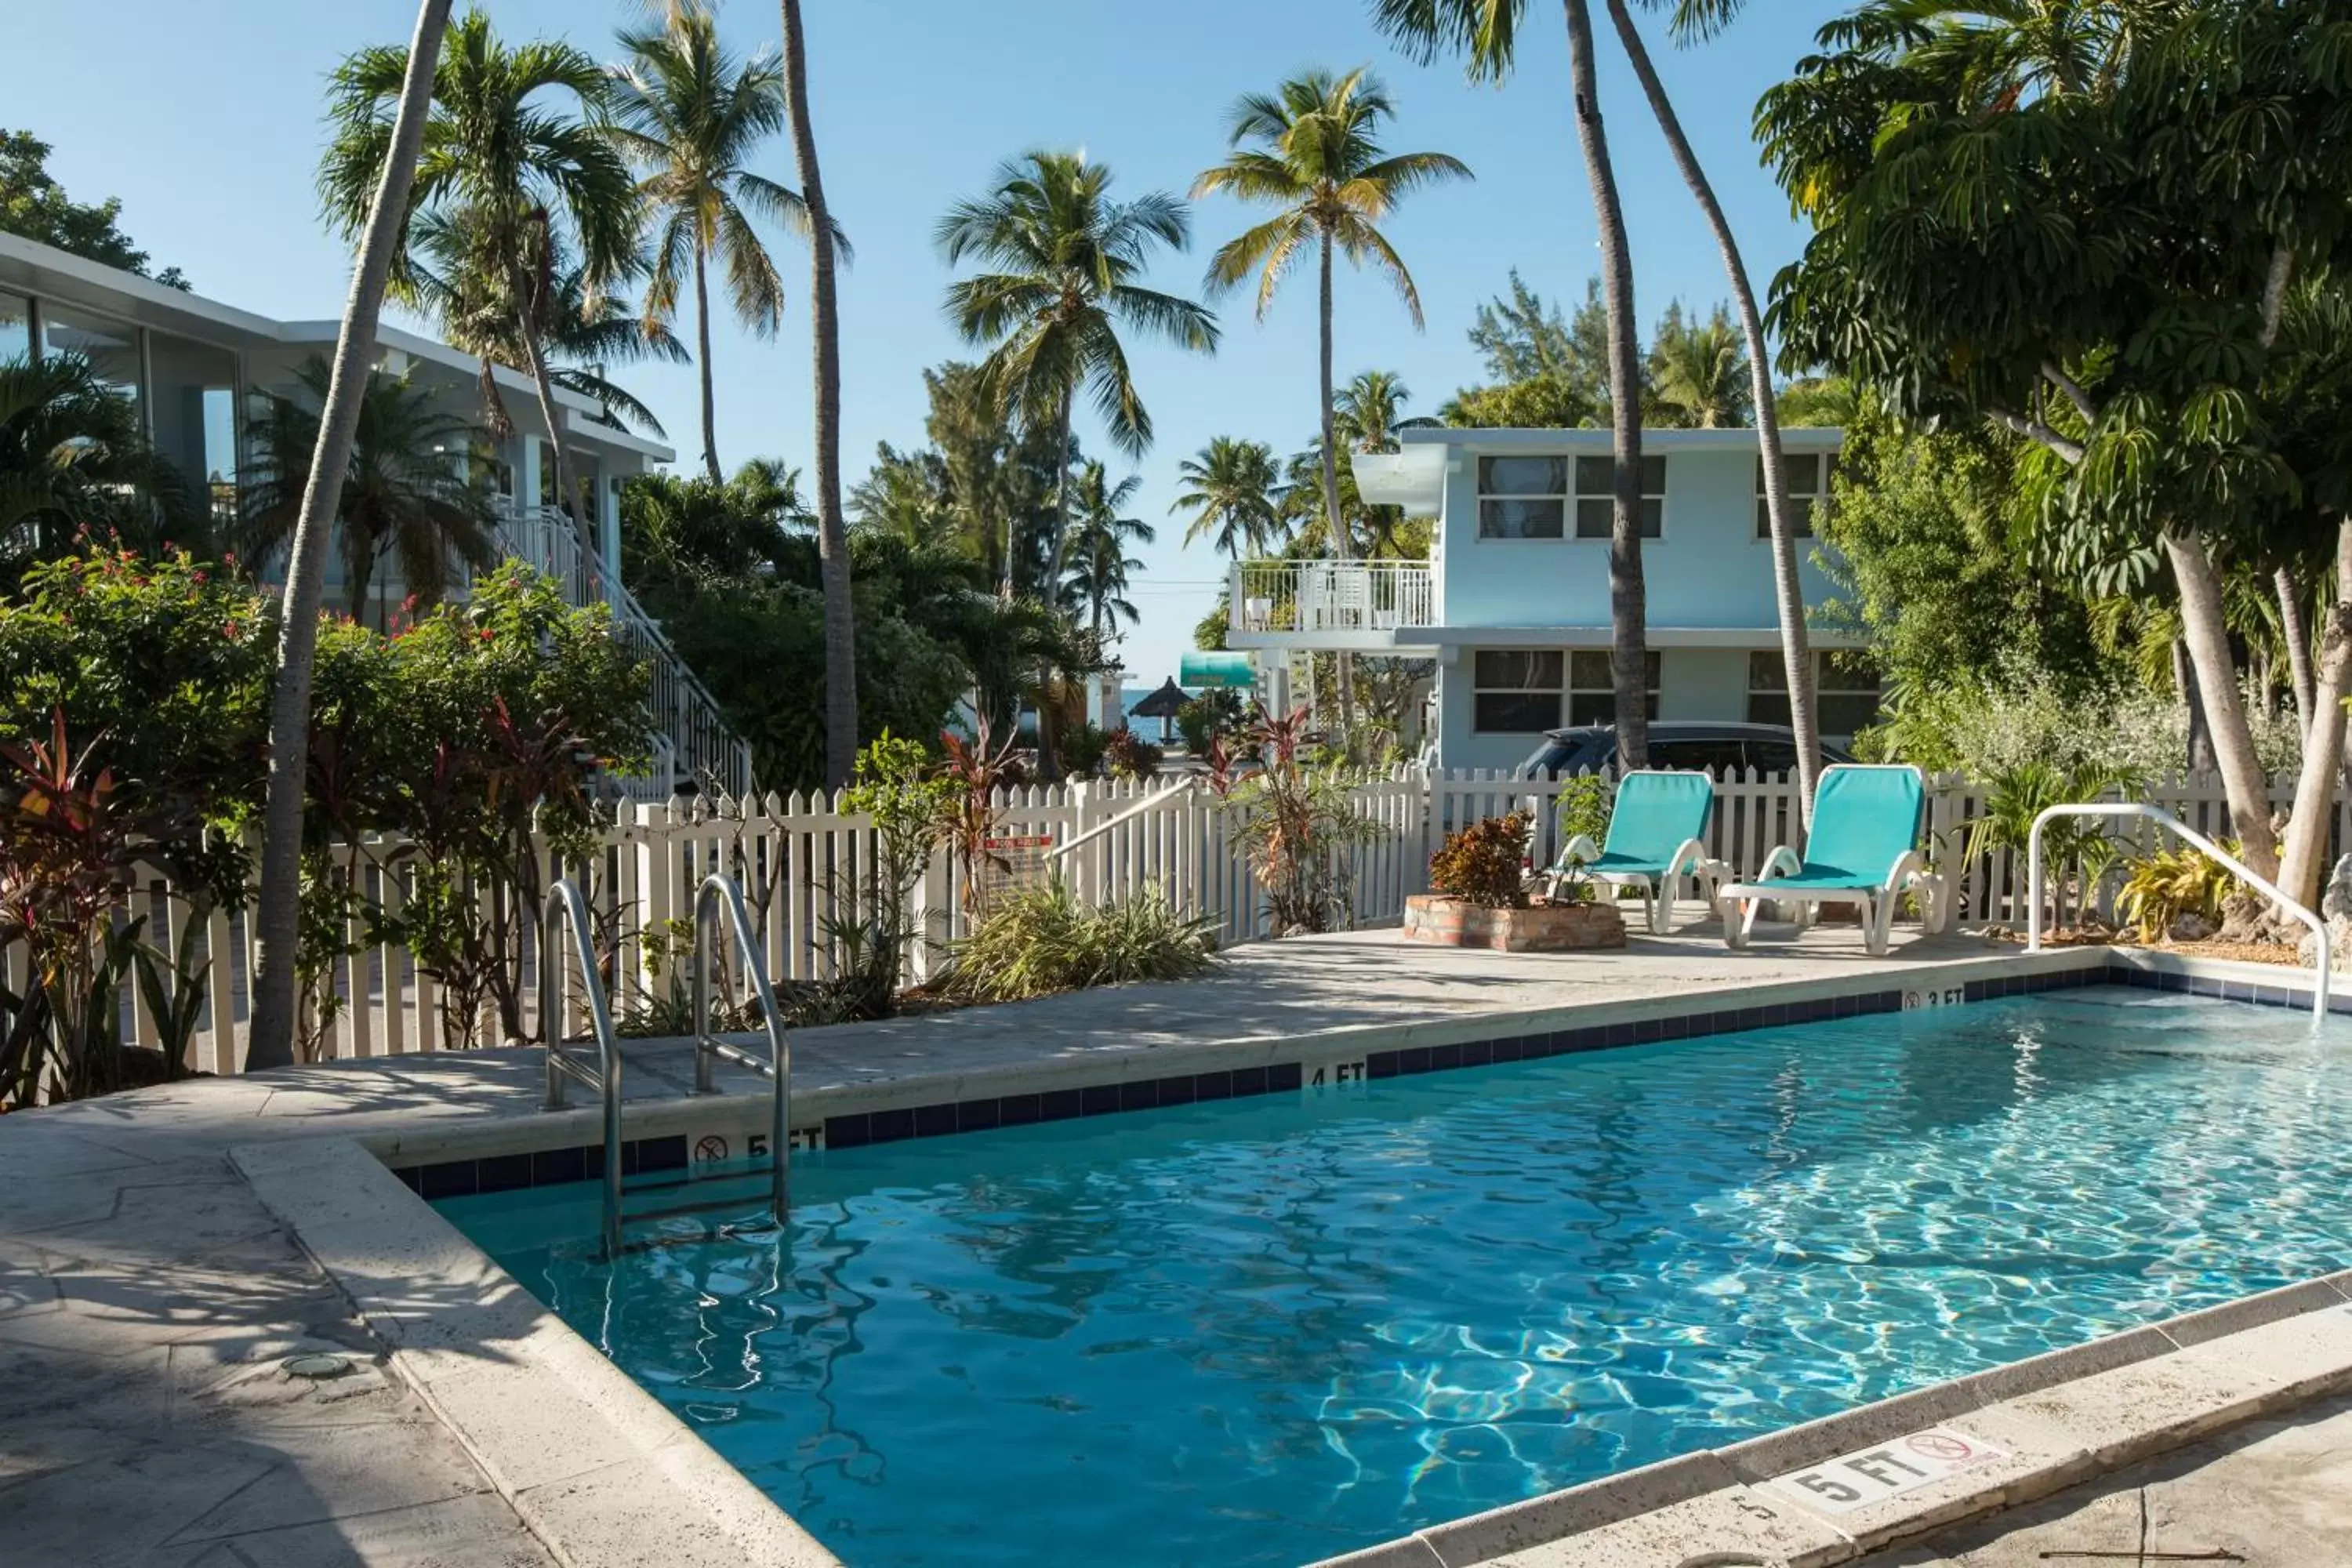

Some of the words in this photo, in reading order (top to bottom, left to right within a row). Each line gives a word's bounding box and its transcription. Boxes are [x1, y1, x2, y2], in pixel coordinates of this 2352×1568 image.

[1944, 989, 1962, 1004] FT
[1312, 1067, 1325, 1085] 4
[1337, 1062, 1364, 1083] FT
[747, 1134, 768, 1157] 5
[1794, 1473, 1862, 1503] 5
[1844, 1450, 1929, 1486] FT
